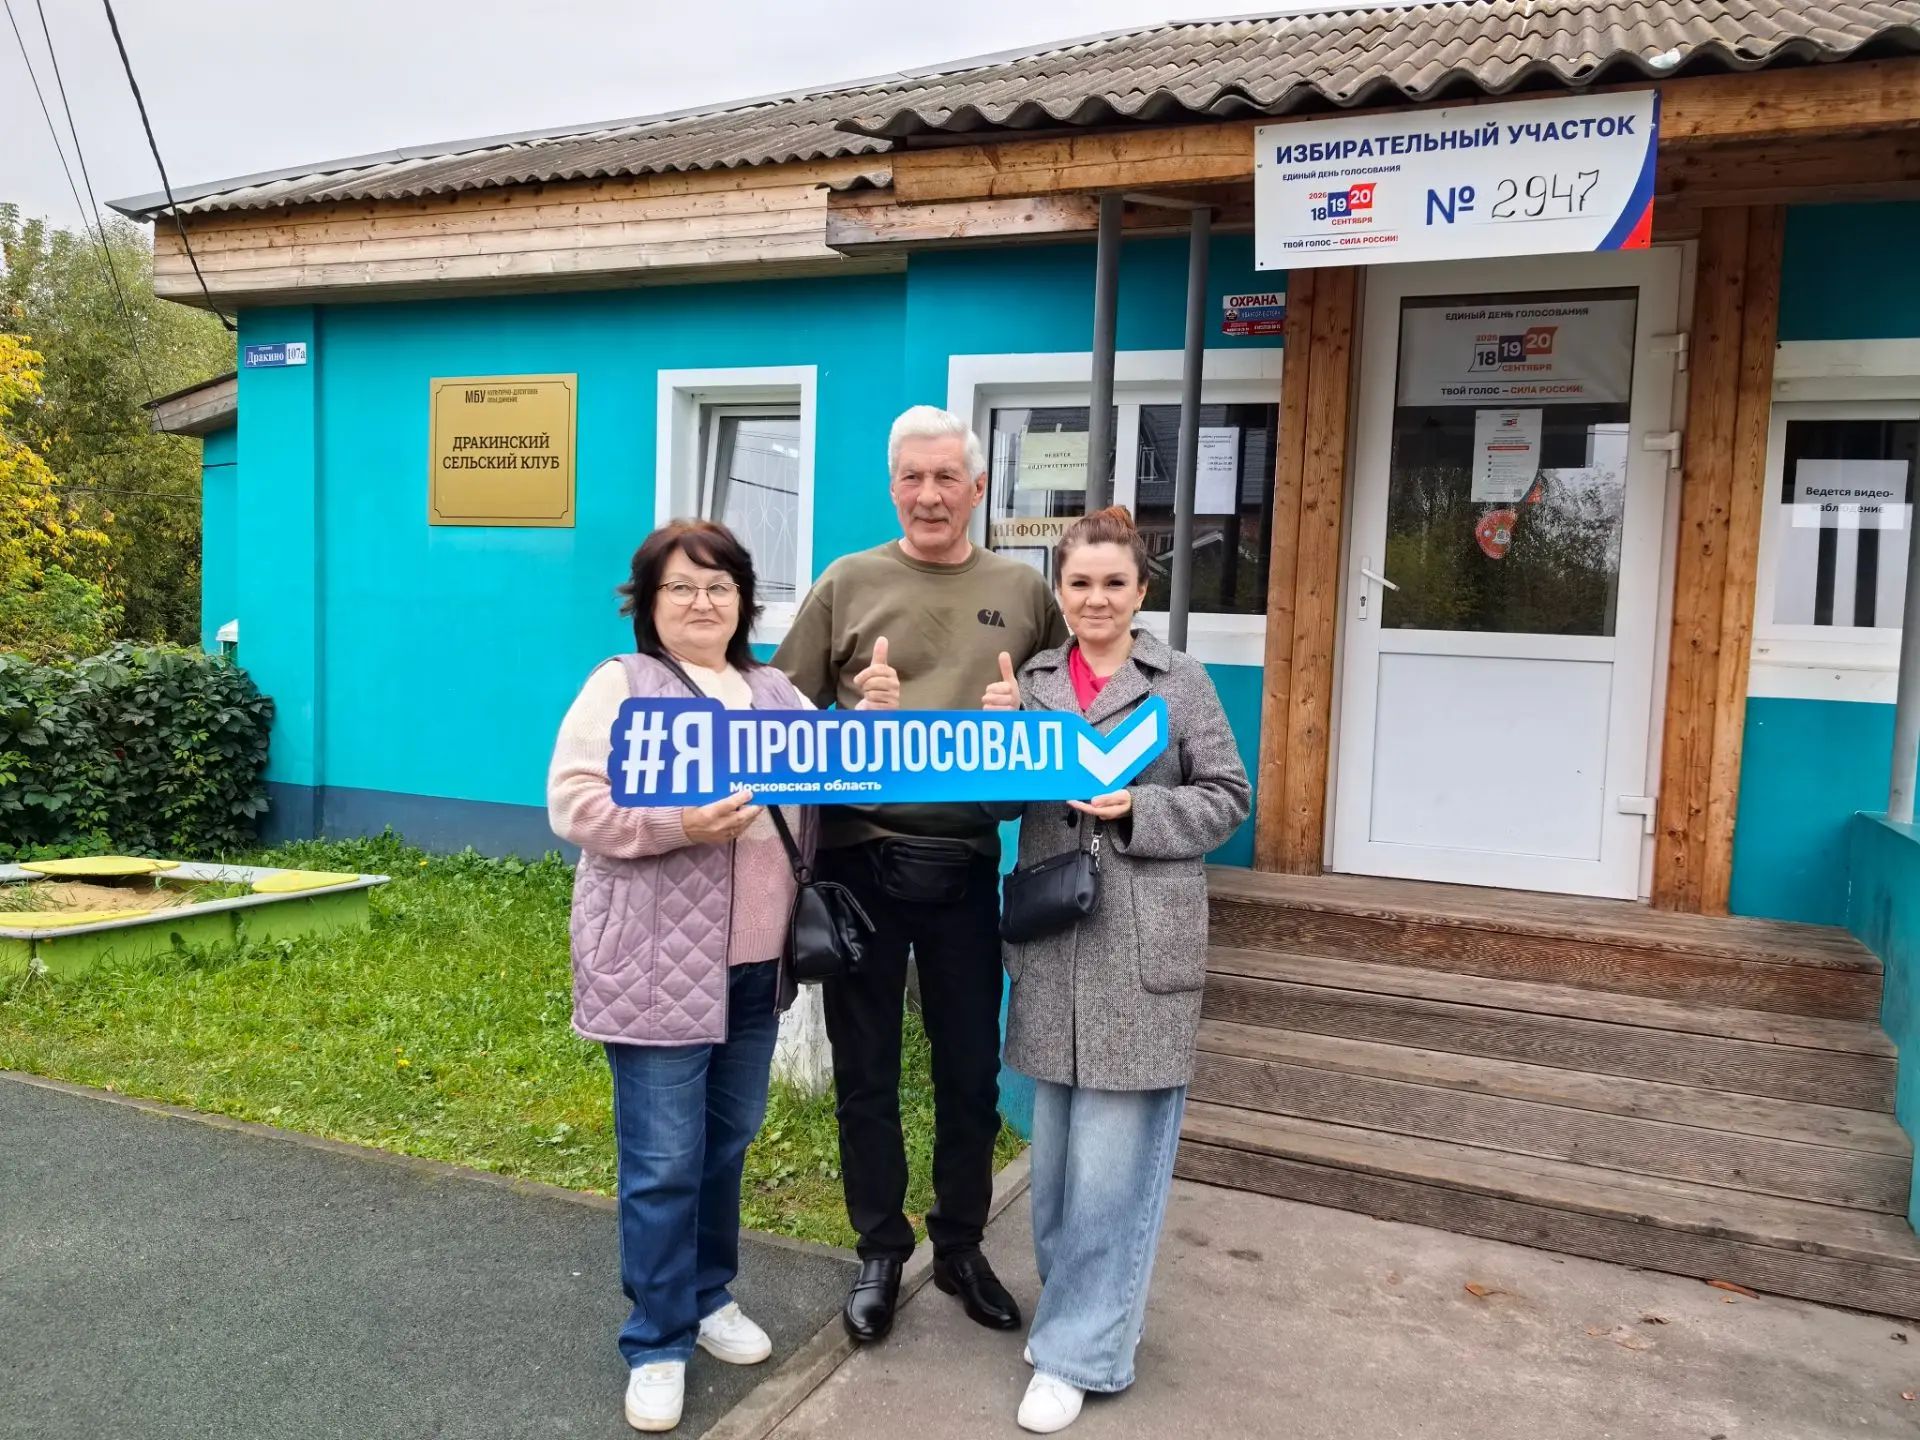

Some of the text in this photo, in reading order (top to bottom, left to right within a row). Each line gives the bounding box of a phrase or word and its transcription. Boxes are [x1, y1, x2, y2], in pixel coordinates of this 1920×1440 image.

[1275, 114, 1637, 166] ИЗБИРАТЕЛЬНЫЙ УЧАСТОК
[1282, 164, 1401, 182] ЕДИНЫЙ ДЕНЬ ГОЛОСОВАНИЯ
[1425, 169, 1600, 226] № 2947
[1310, 189, 1371, 222] 18 19 20
[1331, 216, 1373, 226] СЕНТЯБРЯ
[1283, 239, 1304, 249] ТВОЙ
[1305, 238, 1331, 248] ГОЛОС
[1339, 237, 1361, 246] СИЛА
[1362, 235, 1399, 245] РОССИИ!
[1229, 294, 1278, 307] ОХРАНА
[1445, 307, 1589, 321] ЕДИНЫЙ ДЕНЬ ГОЛОСОВАНИЯ
[246, 351, 285, 366] Дракино
[287, 347, 306, 360] 107а
[1477, 333, 1551, 366] 18 19 20
[1502, 363, 1553, 372] СЕНТЯБРЯ
[464, 389, 487, 404] МБУ
[1441, 385, 1467, 396] ТВОЙ
[1468, 386, 1500, 395] ГОЛОС
[1510, 386, 1537, 394] СИЛА
[1539, 385, 1583, 394] РОССИИ!
[452, 432, 550, 452] ДРАКИНСКИЙ
[442, 452, 560, 470] СЕЛЬСКИЙ КЛУБ
[1805, 486, 1895, 500] Ведется видео-
[994, 523, 1064, 537] ИНФОРМ
[621, 709, 1066, 795] #Я ПРОГОЛОСОВАЛ
[729, 779, 882, 793] Московская область
